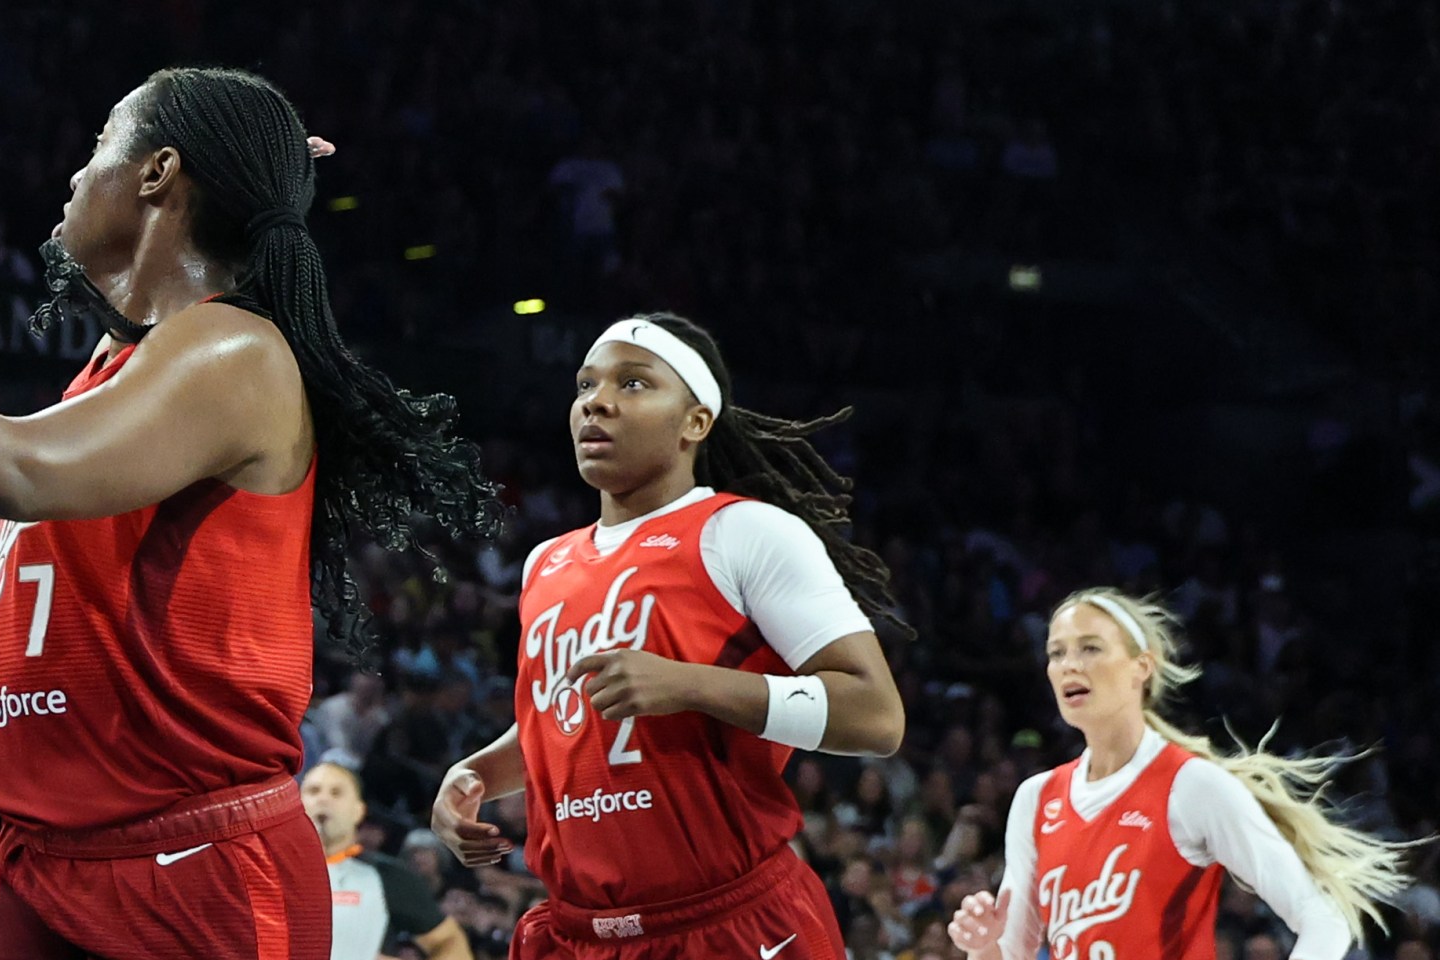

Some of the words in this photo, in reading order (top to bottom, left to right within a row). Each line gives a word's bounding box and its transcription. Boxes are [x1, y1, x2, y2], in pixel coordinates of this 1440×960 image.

[18, 563, 54, 657] 7
[526, 566, 656, 714] Indy
[1038, 844, 1142, 942] Indy
